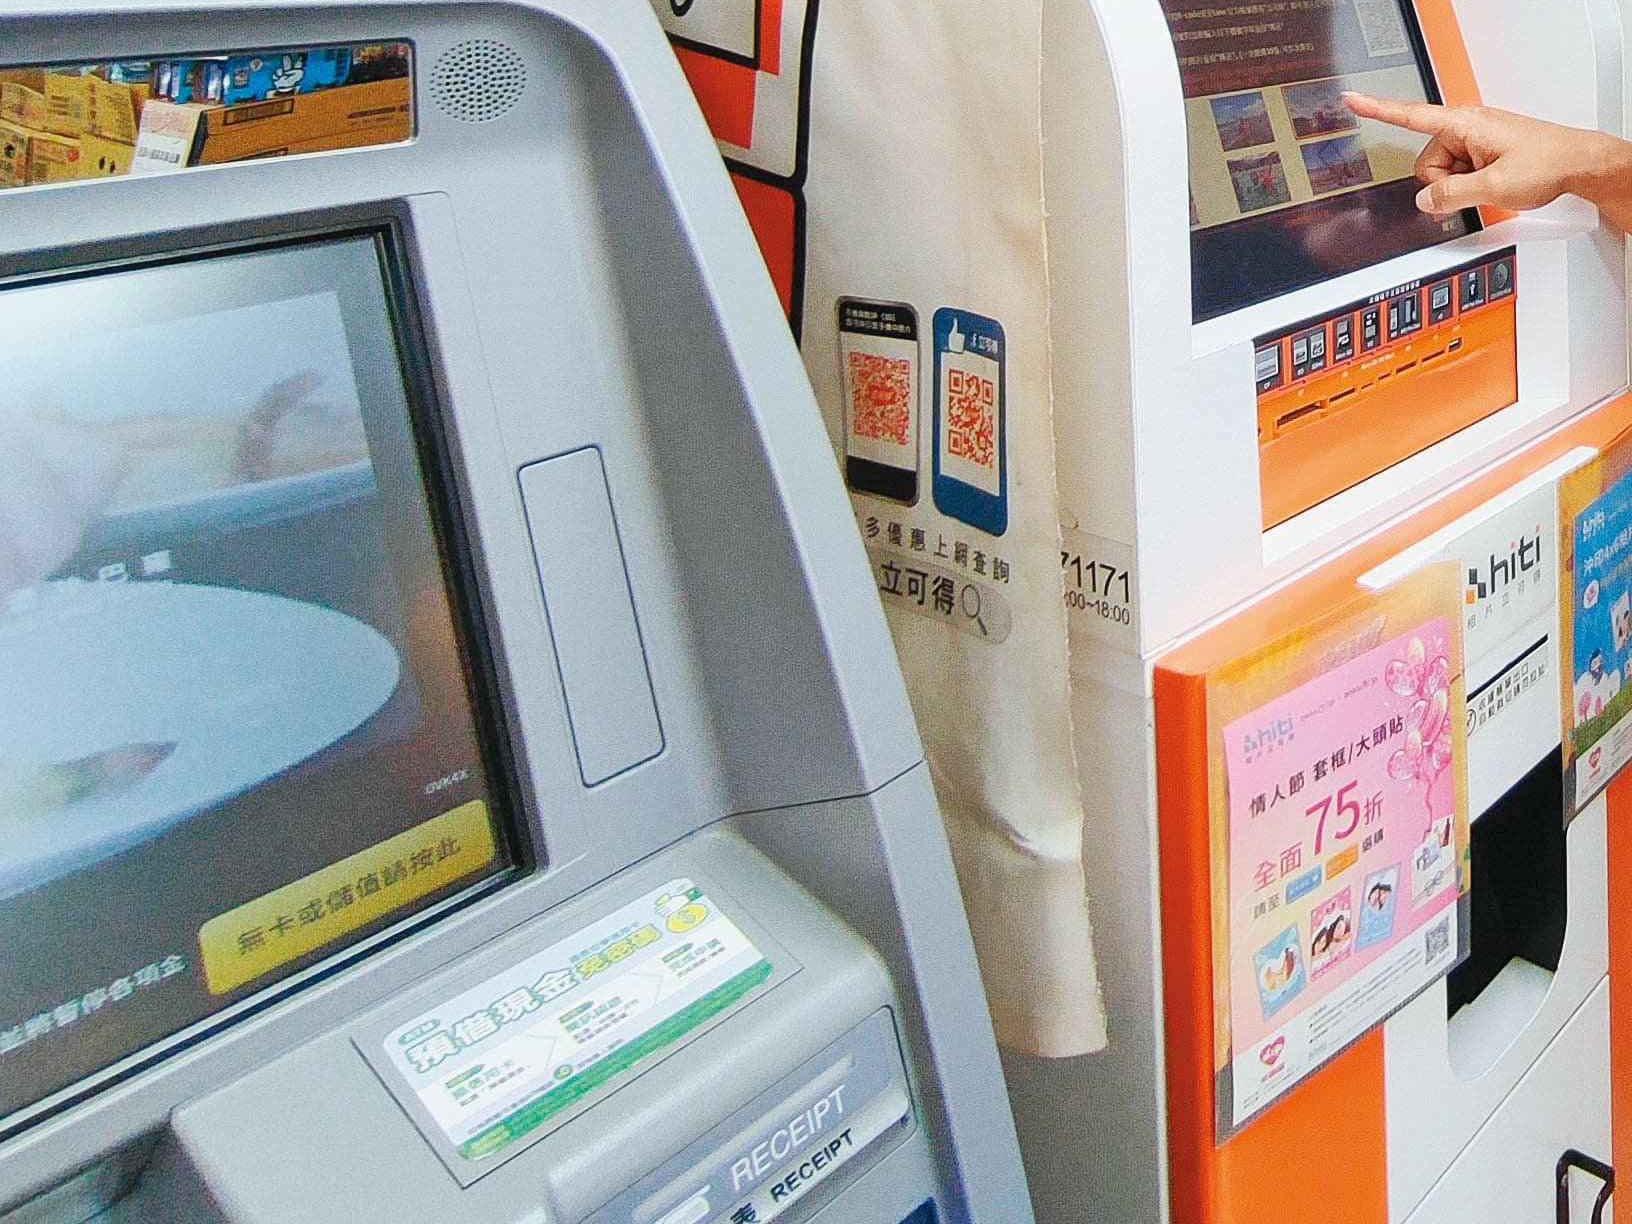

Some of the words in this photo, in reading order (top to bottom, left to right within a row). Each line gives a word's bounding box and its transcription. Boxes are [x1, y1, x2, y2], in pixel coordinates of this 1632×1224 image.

[880, 560, 955, 616] 立可得
[1490, 524, 1541, 595] hiti
[404, 967, 580, 1074] 預借現金
[731, 1084, 846, 1192] RECEIPT
[770, 1127, 854, 1204] RECEIPT
